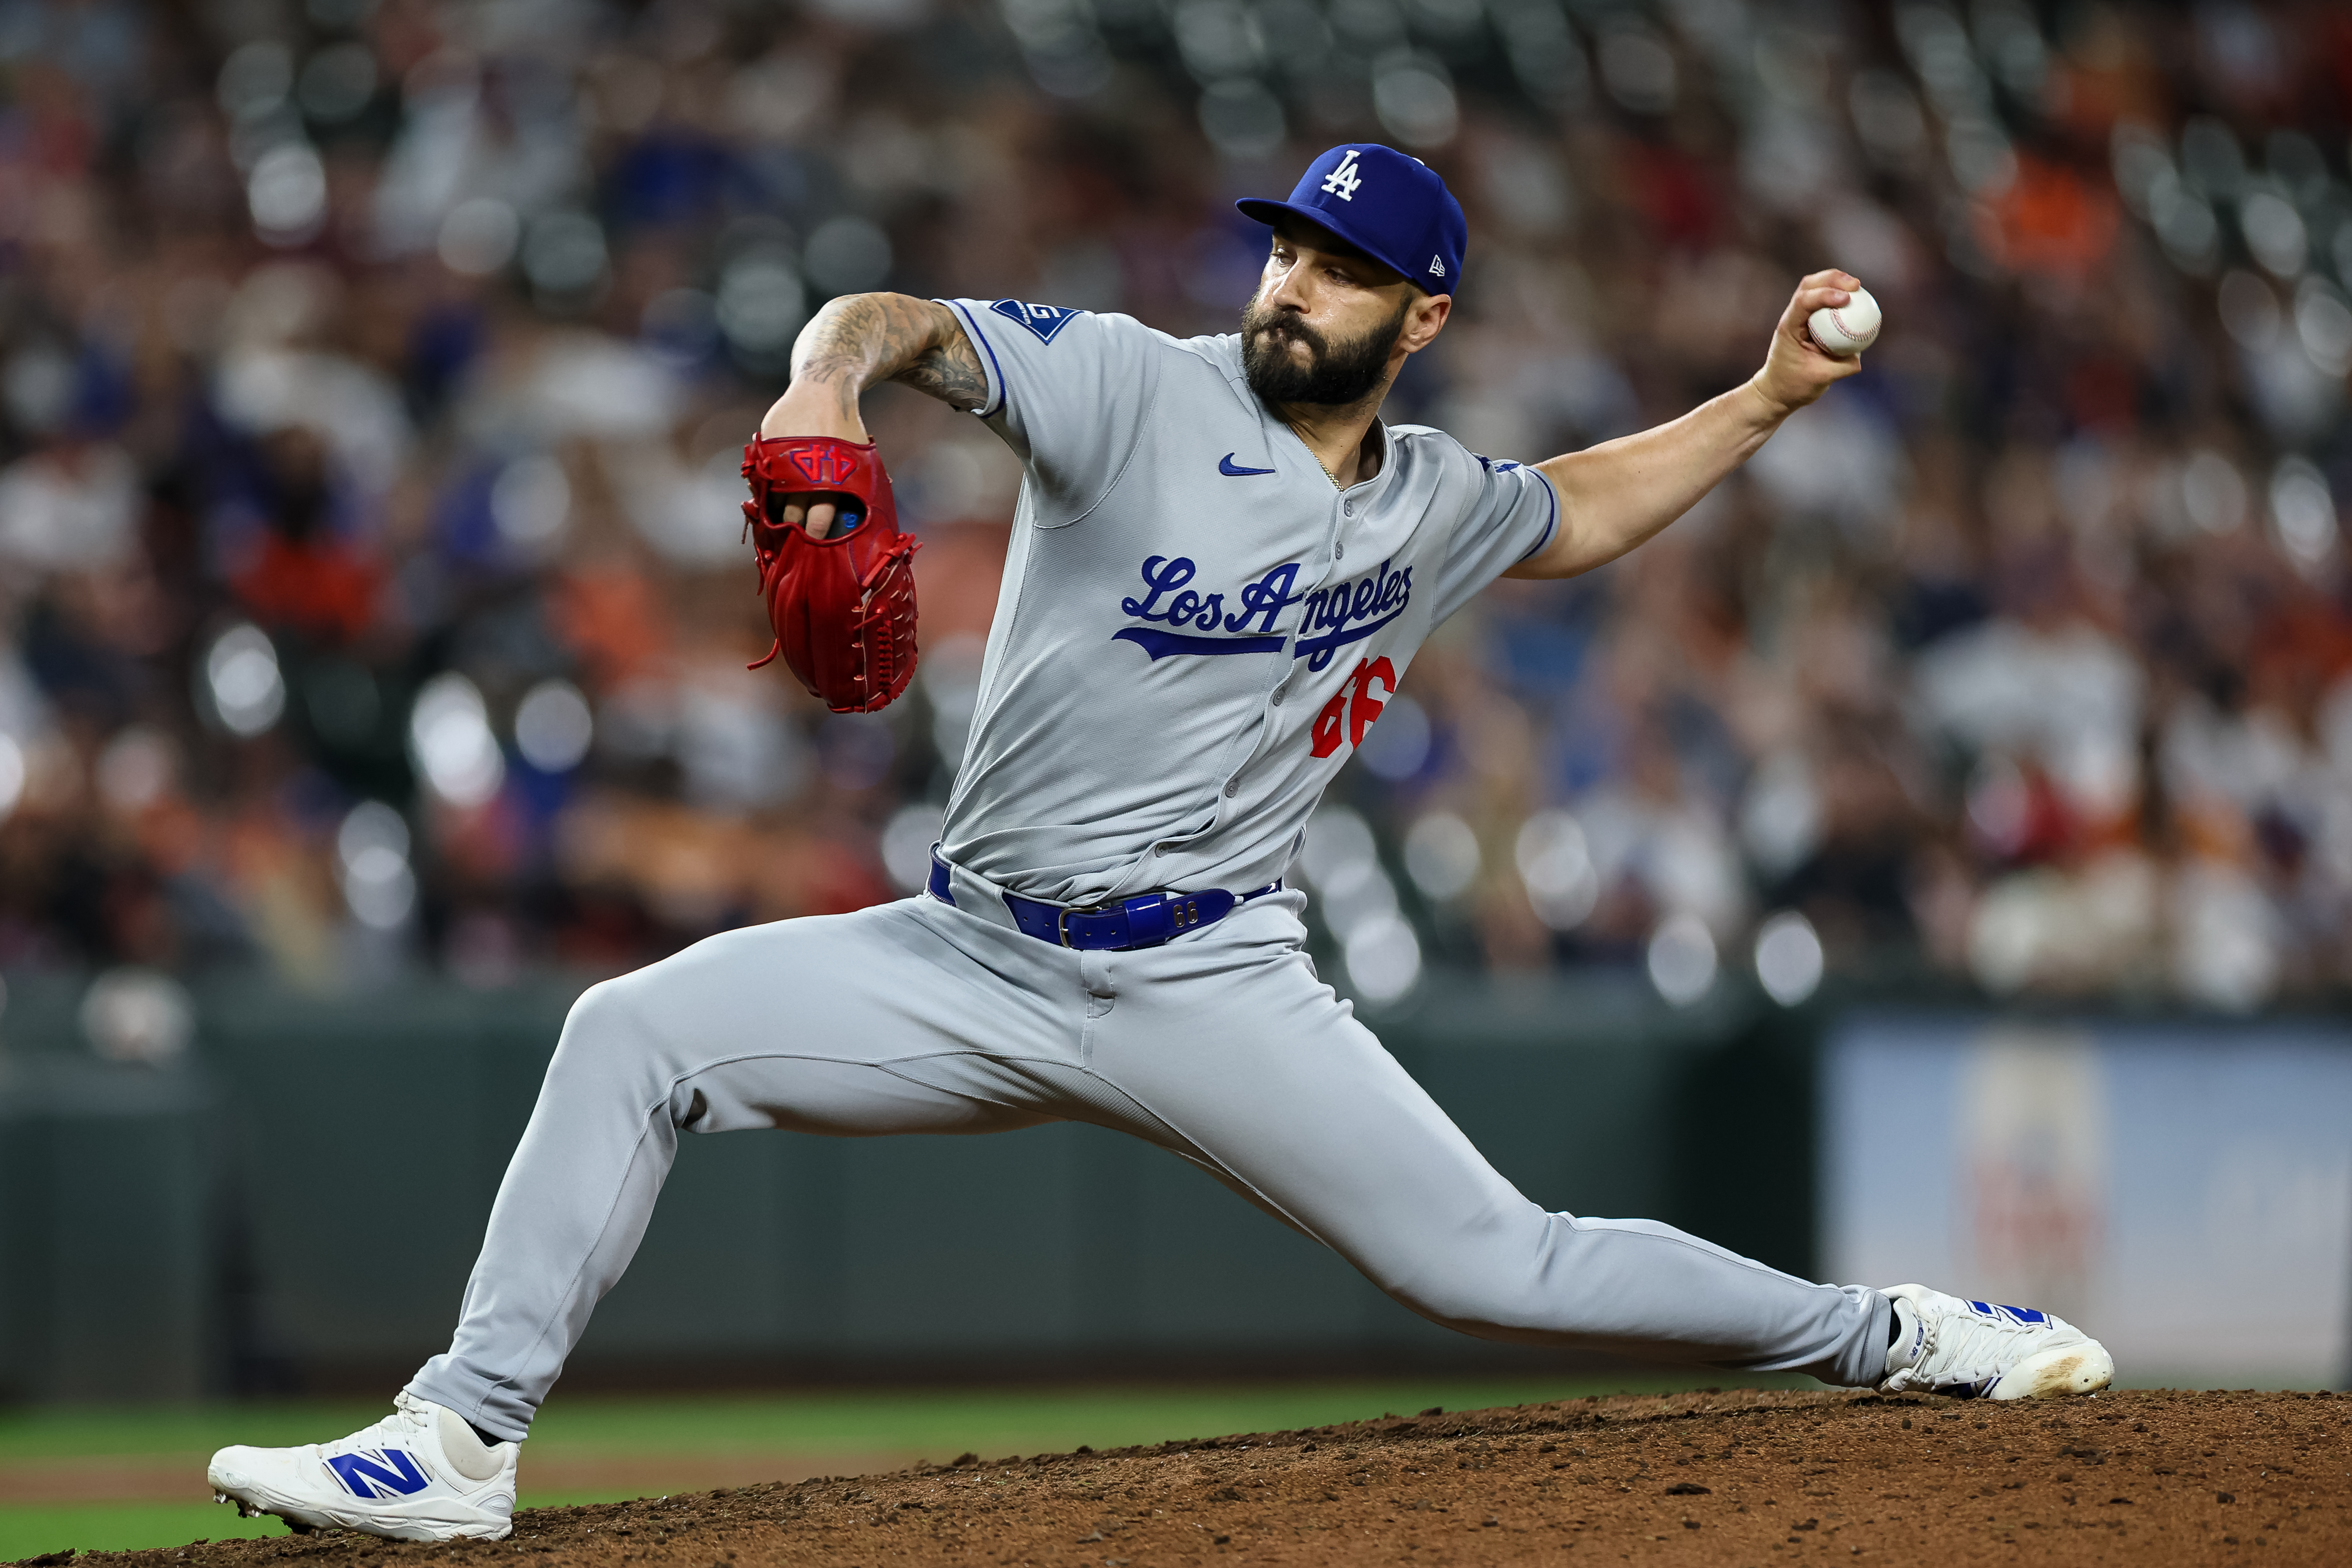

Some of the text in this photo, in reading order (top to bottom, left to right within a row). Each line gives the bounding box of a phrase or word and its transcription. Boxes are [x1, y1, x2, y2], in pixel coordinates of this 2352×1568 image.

[1321, 150, 1362, 202] LA
[1121, 555, 1412, 672] Los Angeles
[1309, 655, 1396, 759] 66
[1173, 901, 1198, 928] 66
[327, 1448, 430, 1499] N
